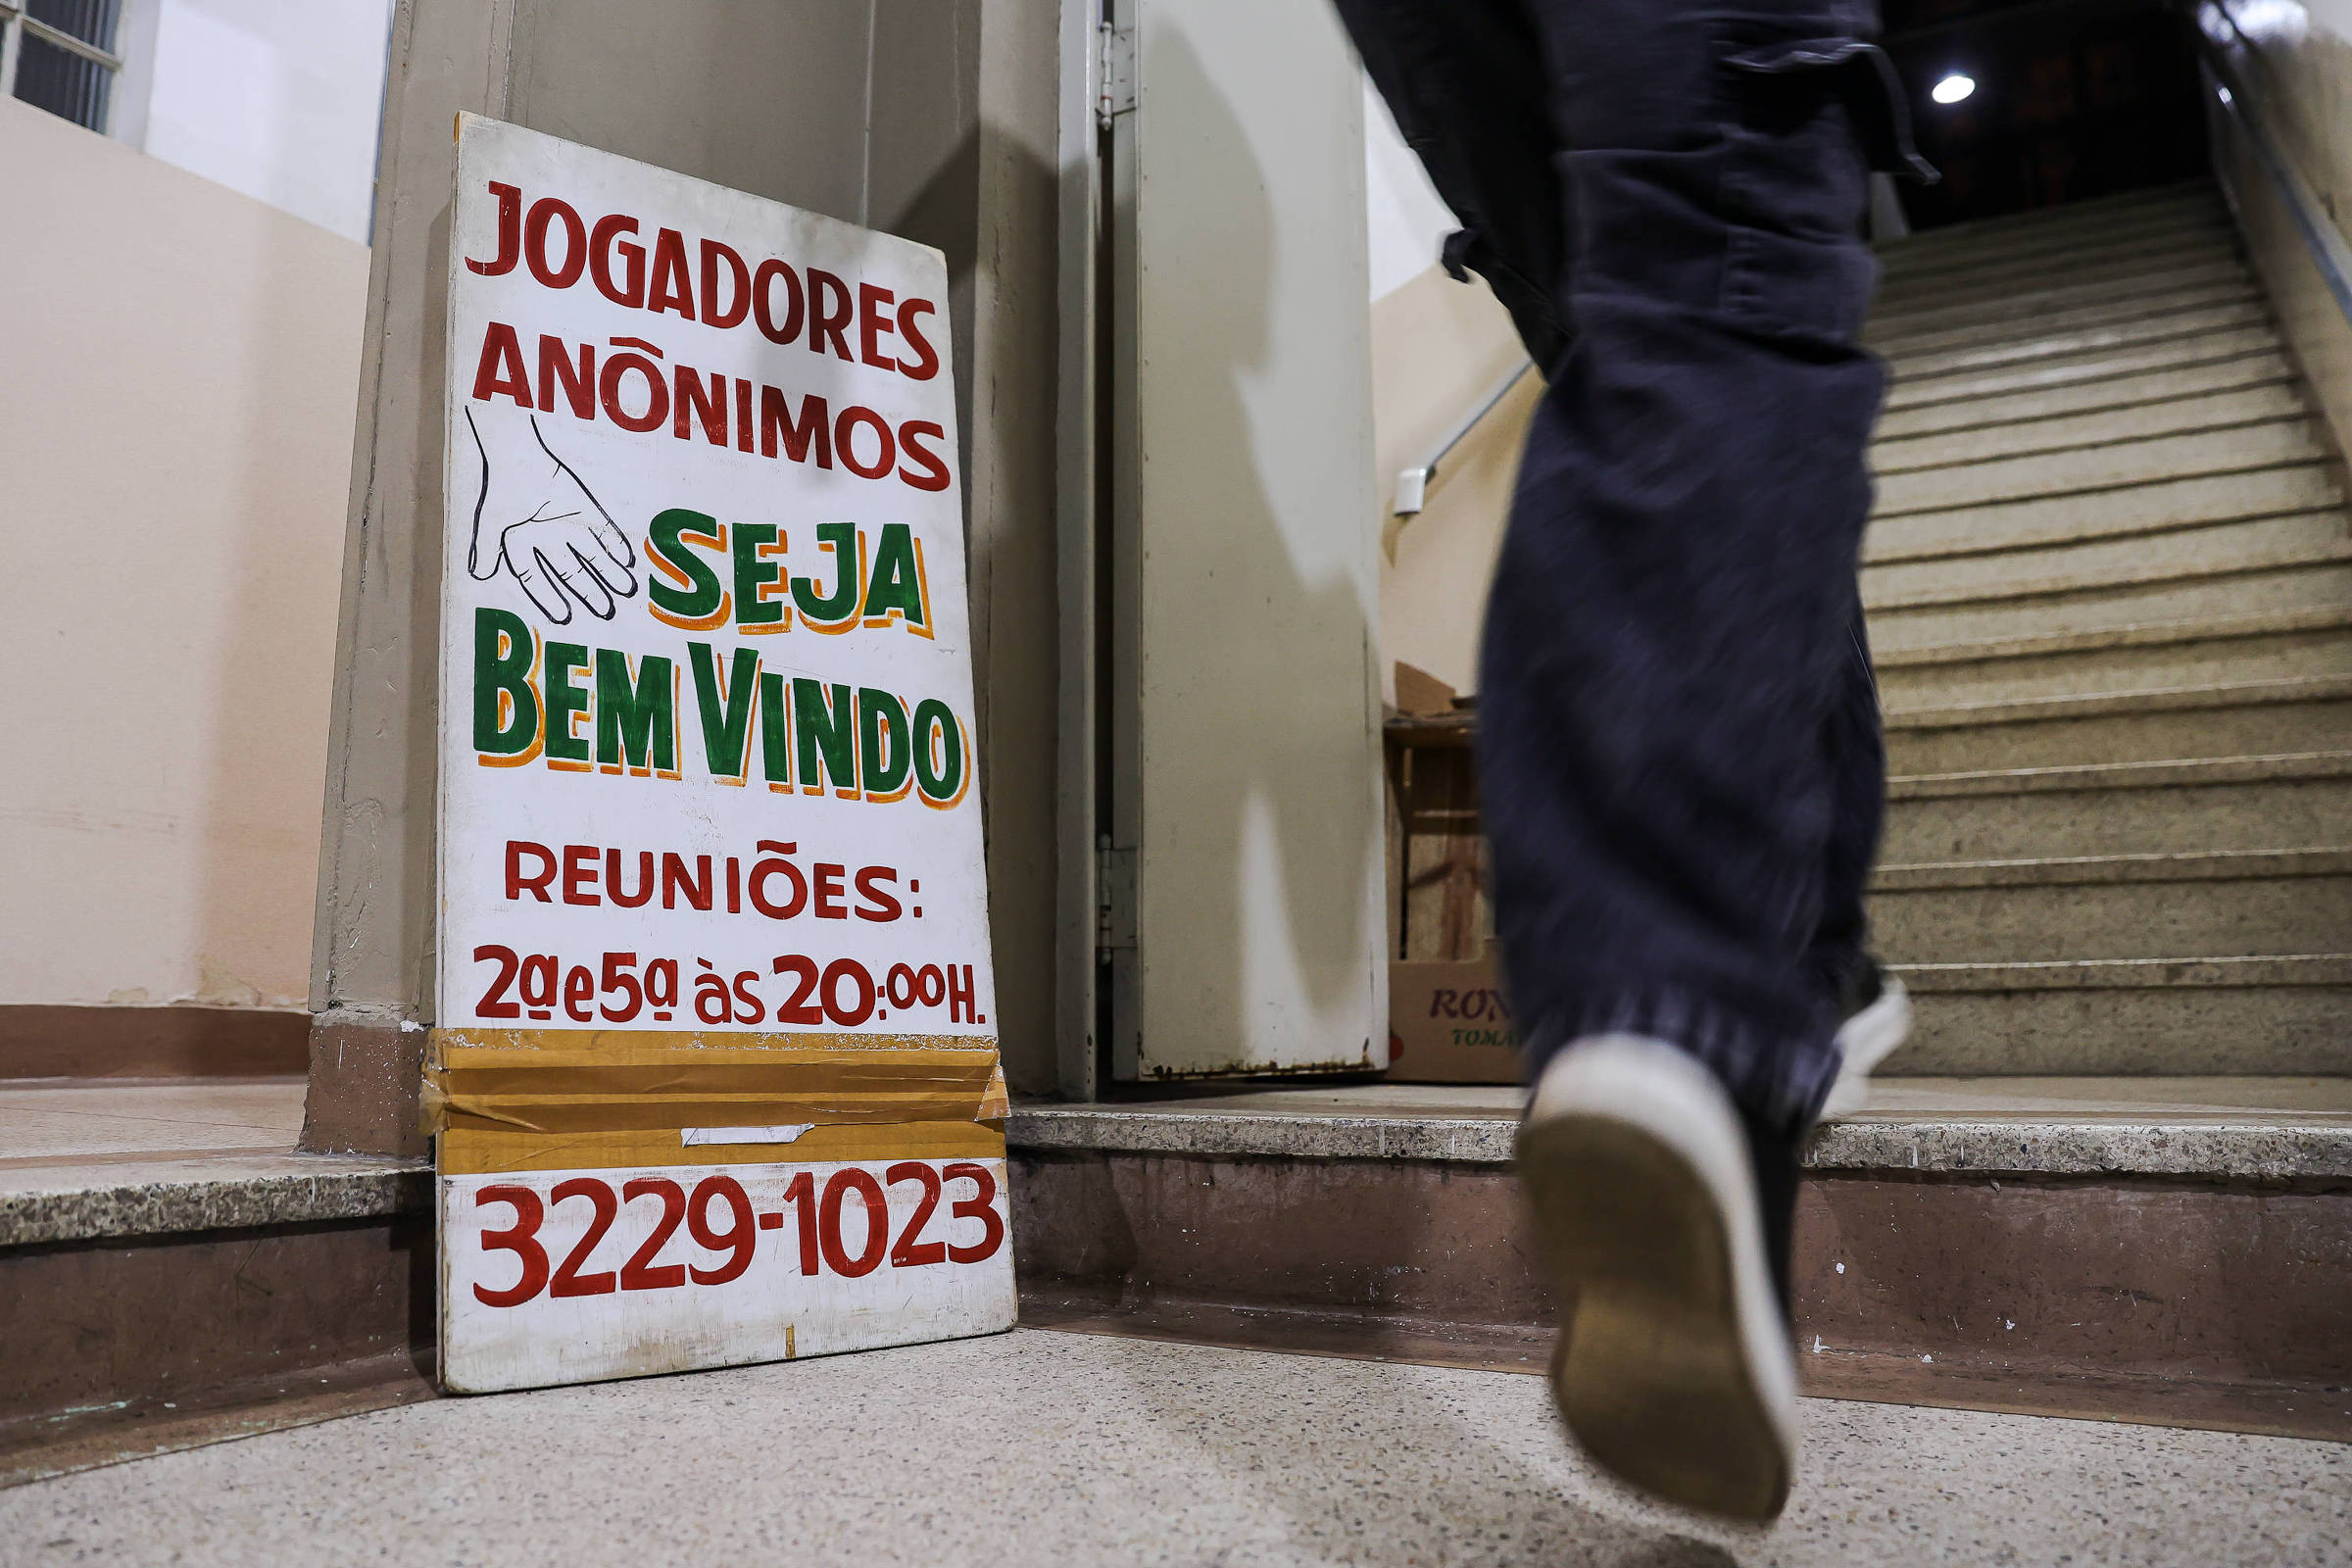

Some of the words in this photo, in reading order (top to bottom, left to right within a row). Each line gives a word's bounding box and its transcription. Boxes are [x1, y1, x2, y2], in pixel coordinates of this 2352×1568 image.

[465, 180, 939, 380] JOGADORES
[472, 321, 951, 492] ANÔNIMOS
[645, 508, 935, 641] SEJA
[473, 607, 682, 781] BEM
[687, 641, 971, 811] VINDO
[505, 840, 923, 923] REUNIÕES:
[694, 956, 766, 1025] às
[472, 1161, 1004, 1308] 3229-1023
